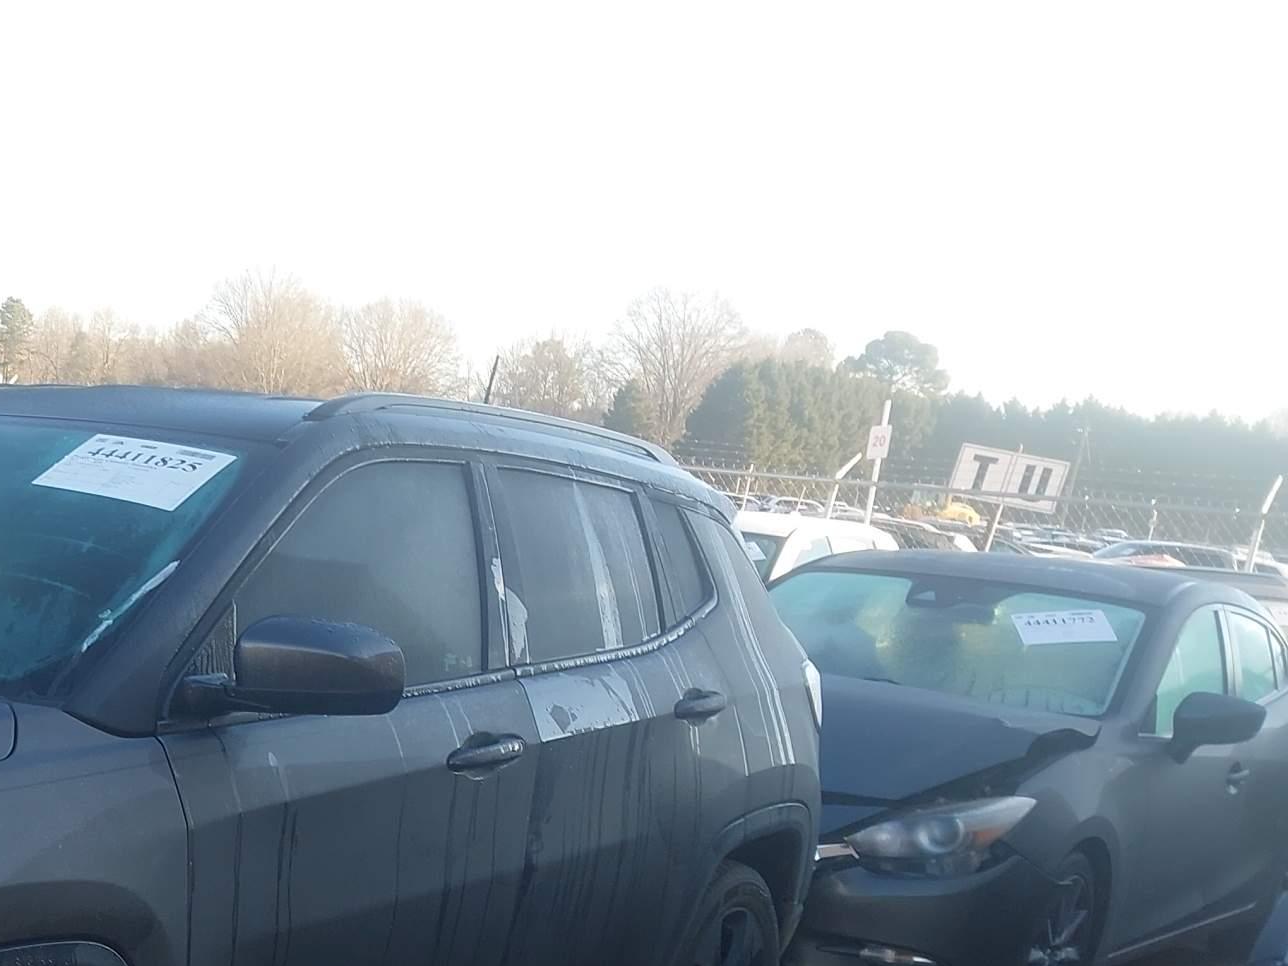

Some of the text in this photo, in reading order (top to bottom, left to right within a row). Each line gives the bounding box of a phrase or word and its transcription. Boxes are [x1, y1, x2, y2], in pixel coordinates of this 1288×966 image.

[871, 434, 887, 448] 20
[88, 447, 203, 472] 44411825
[973, 454, 1000, 490] T
